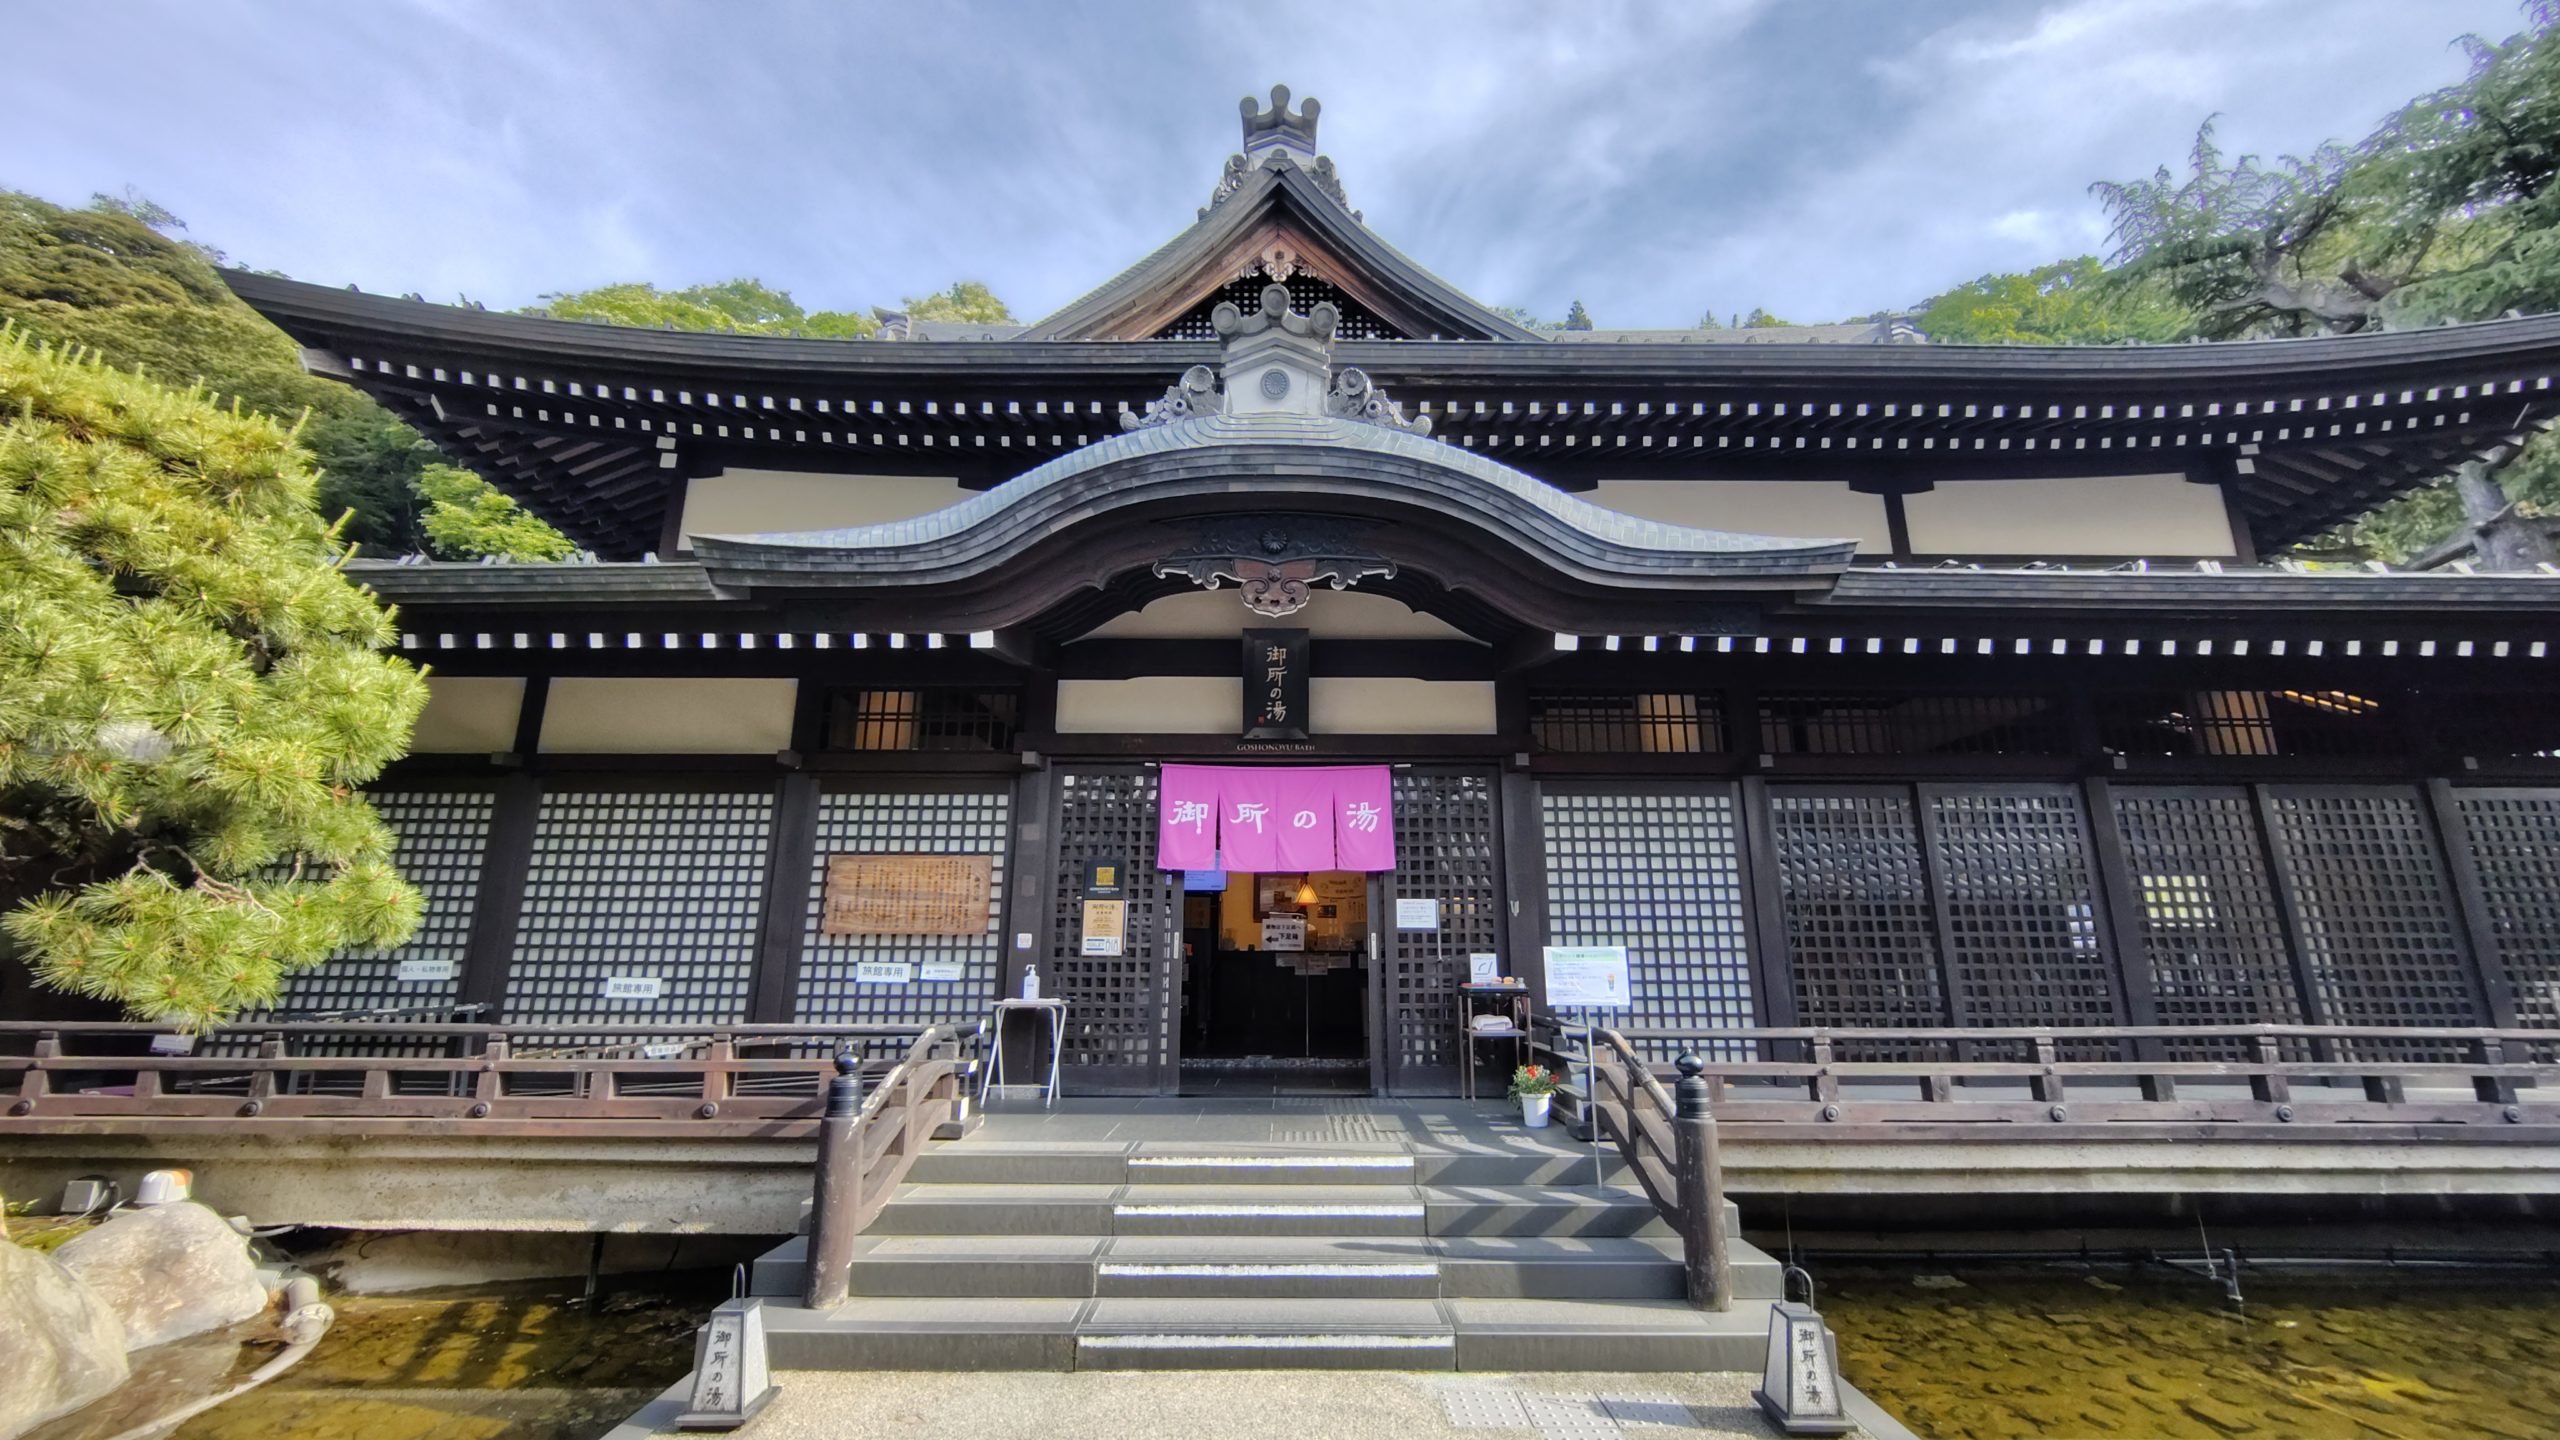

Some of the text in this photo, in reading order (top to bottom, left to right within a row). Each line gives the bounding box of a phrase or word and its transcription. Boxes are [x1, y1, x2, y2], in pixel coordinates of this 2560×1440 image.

[1265, 646, 1287, 722] 御所の湯
[1168, 801, 1382, 834] 御所の湯
[612, 982, 654, 994] 旅館専用
[862, 966, 904, 977] 旅館専用
[707, 1331, 731, 1405] 御所の湯
[1798, 1329, 1822, 1404] 御所の湯
